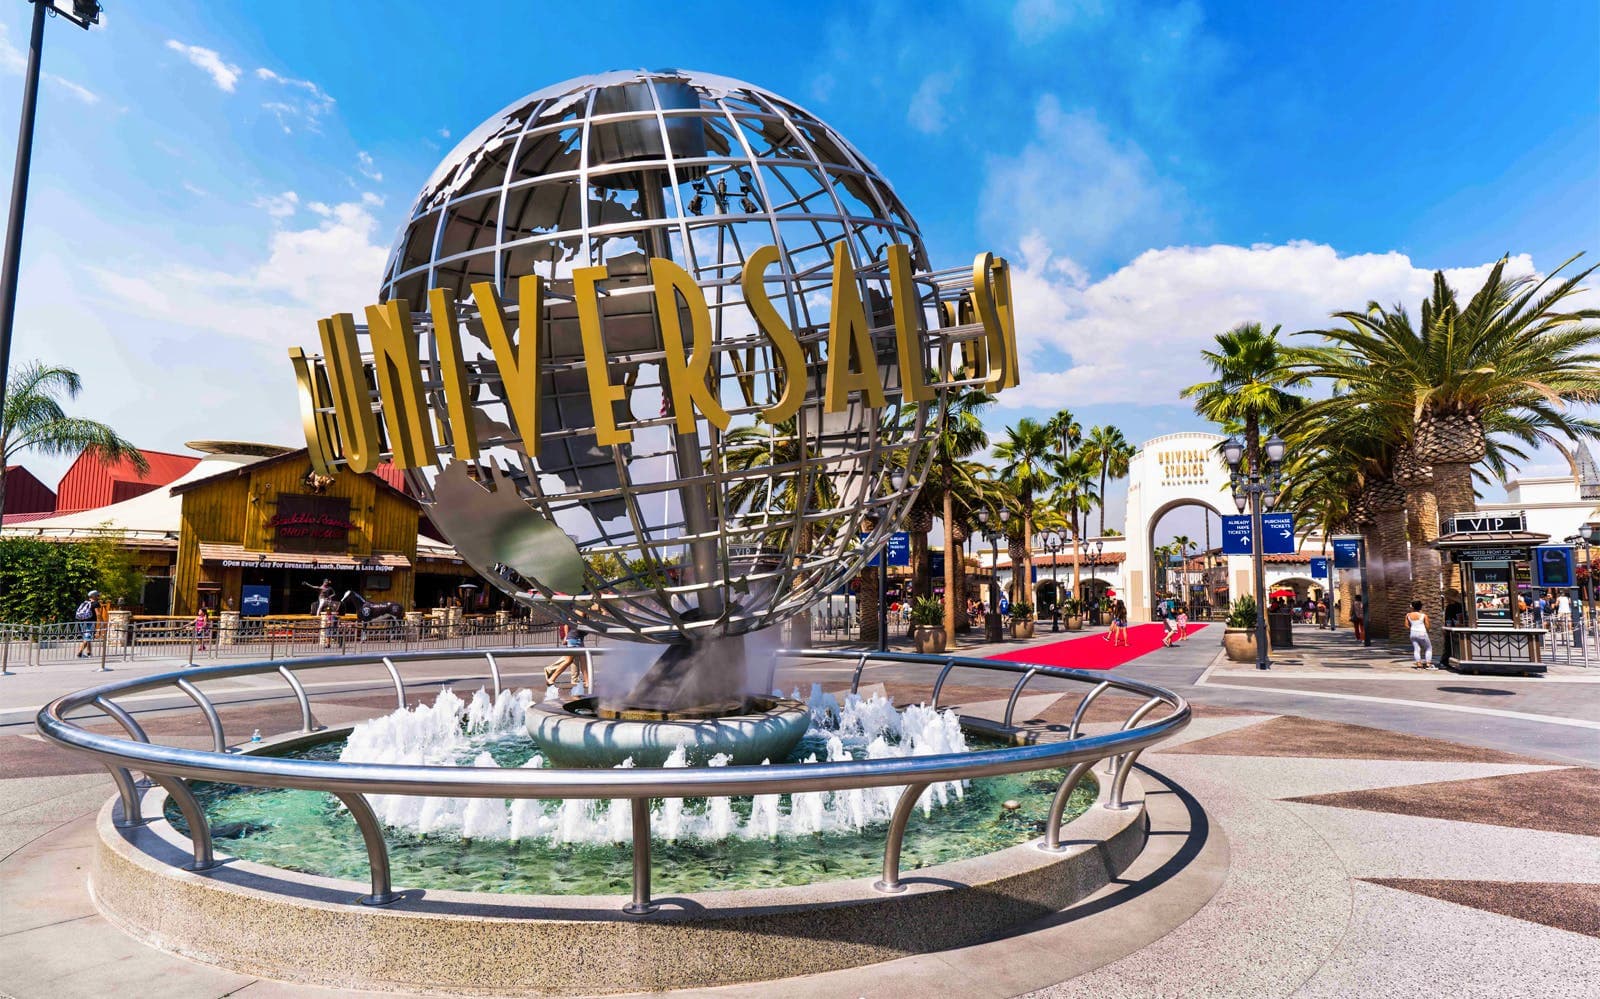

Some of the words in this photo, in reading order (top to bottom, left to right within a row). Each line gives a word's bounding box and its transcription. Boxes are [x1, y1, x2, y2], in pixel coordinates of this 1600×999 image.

[317, 241, 936, 474] UNIVERSAL
[1158, 449, 1209, 465] UNIVERSAL
[1165, 463, 1204, 478] STUDIOS
[1470, 518, 1504, 531] VIP
